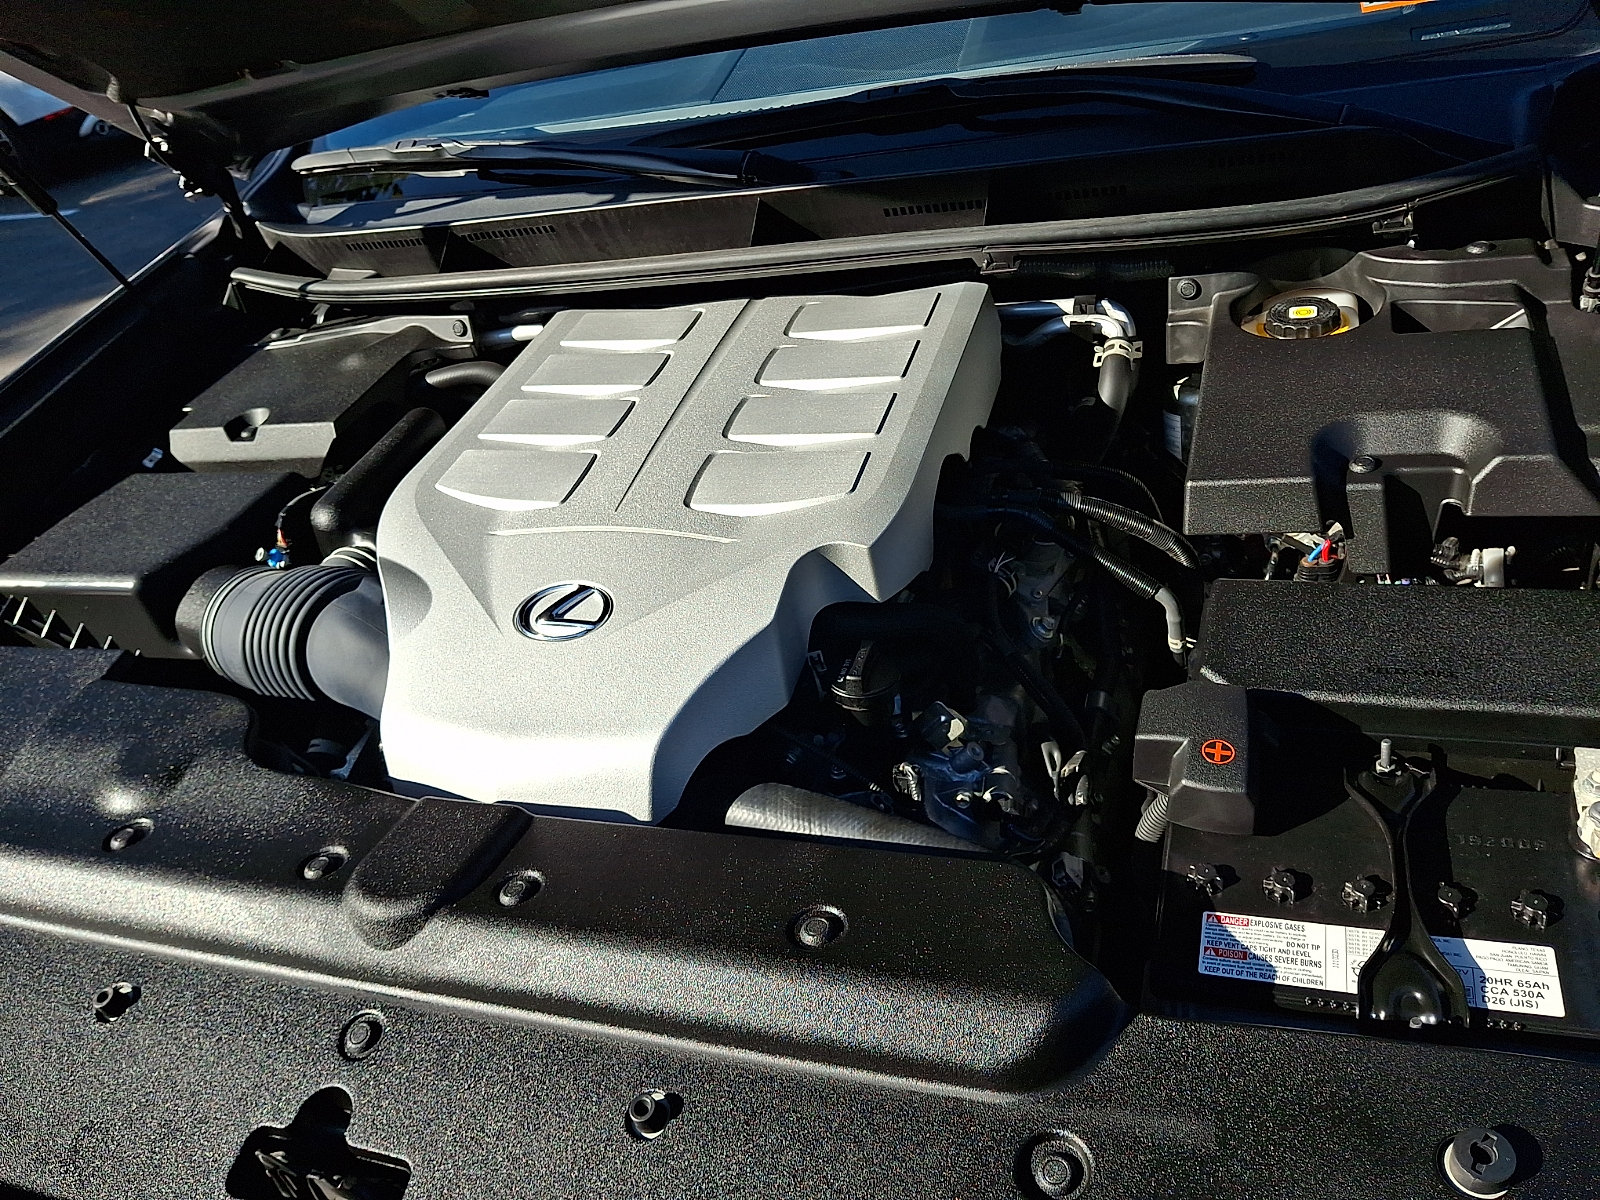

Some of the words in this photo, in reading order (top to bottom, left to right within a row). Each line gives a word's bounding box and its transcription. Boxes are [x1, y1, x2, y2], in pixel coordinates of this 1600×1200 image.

[1220, 915, 1248, 926] DANGER
[1250, 919, 1283, 930] EXPLOSIVE
[1284, 923, 1306, 932] GASES
[1206, 939, 1223, 948] KEEP
[1224, 941, 1240, 950] VENT
[1240, 943, 1258, 951] CAPS
[1259, 945, 1277, 953] TIGHT
[1278, 948, 1291, 956] AND
[1292, 950, 1311, 958] LEVEL
[1218, 949, 1244, 959] POISON
[1248, 952, 1273, 963] CAUSES
[1274, 955, 1299, 966] SEVERE
[1300, 958, 1322, 969] BURNS
[1204, 965, 1221, 973] KEEP
[1221, 967, 1235, 975] OUT
[1245, 970, 1258, 979] THE
[1259, 972, 1281, 981] REACH
[1292, 976, 1324, 986] CHILDREN
[1479, 975, 1513, 987] 20HR
[1517, 979, 1550, 990] 65Ah
[1480, 985, 1510, 996] CCA
[1513, 988, 1546, 1000] 530A
[1481, 995, 1506, 1005] D26
[1509, 998, 1540, 1010] (JIS)
